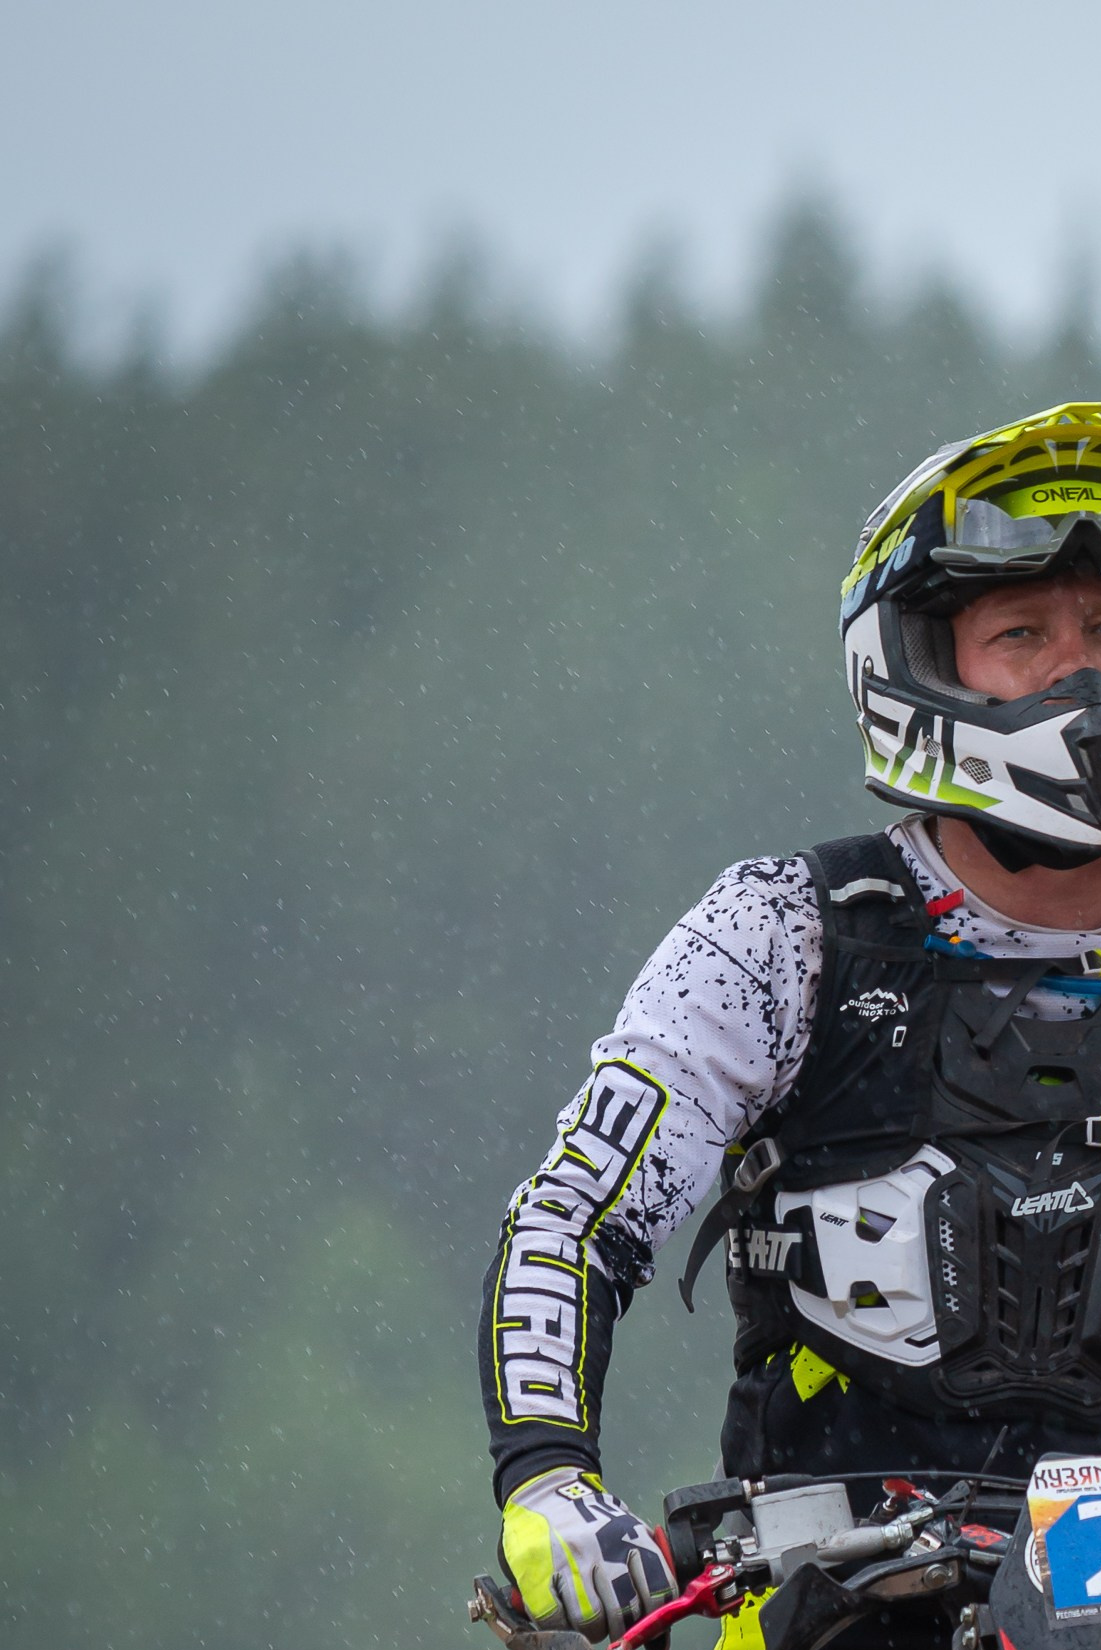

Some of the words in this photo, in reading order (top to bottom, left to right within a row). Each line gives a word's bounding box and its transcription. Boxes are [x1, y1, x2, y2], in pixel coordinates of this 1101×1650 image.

[819, 1212, 849, 1227] LEATT
[1011, 1186, 1078, 1216] LEATT
[503, 1064, 660, 1423] ENDURO
[728, 1228, 803, 1272] EATT
